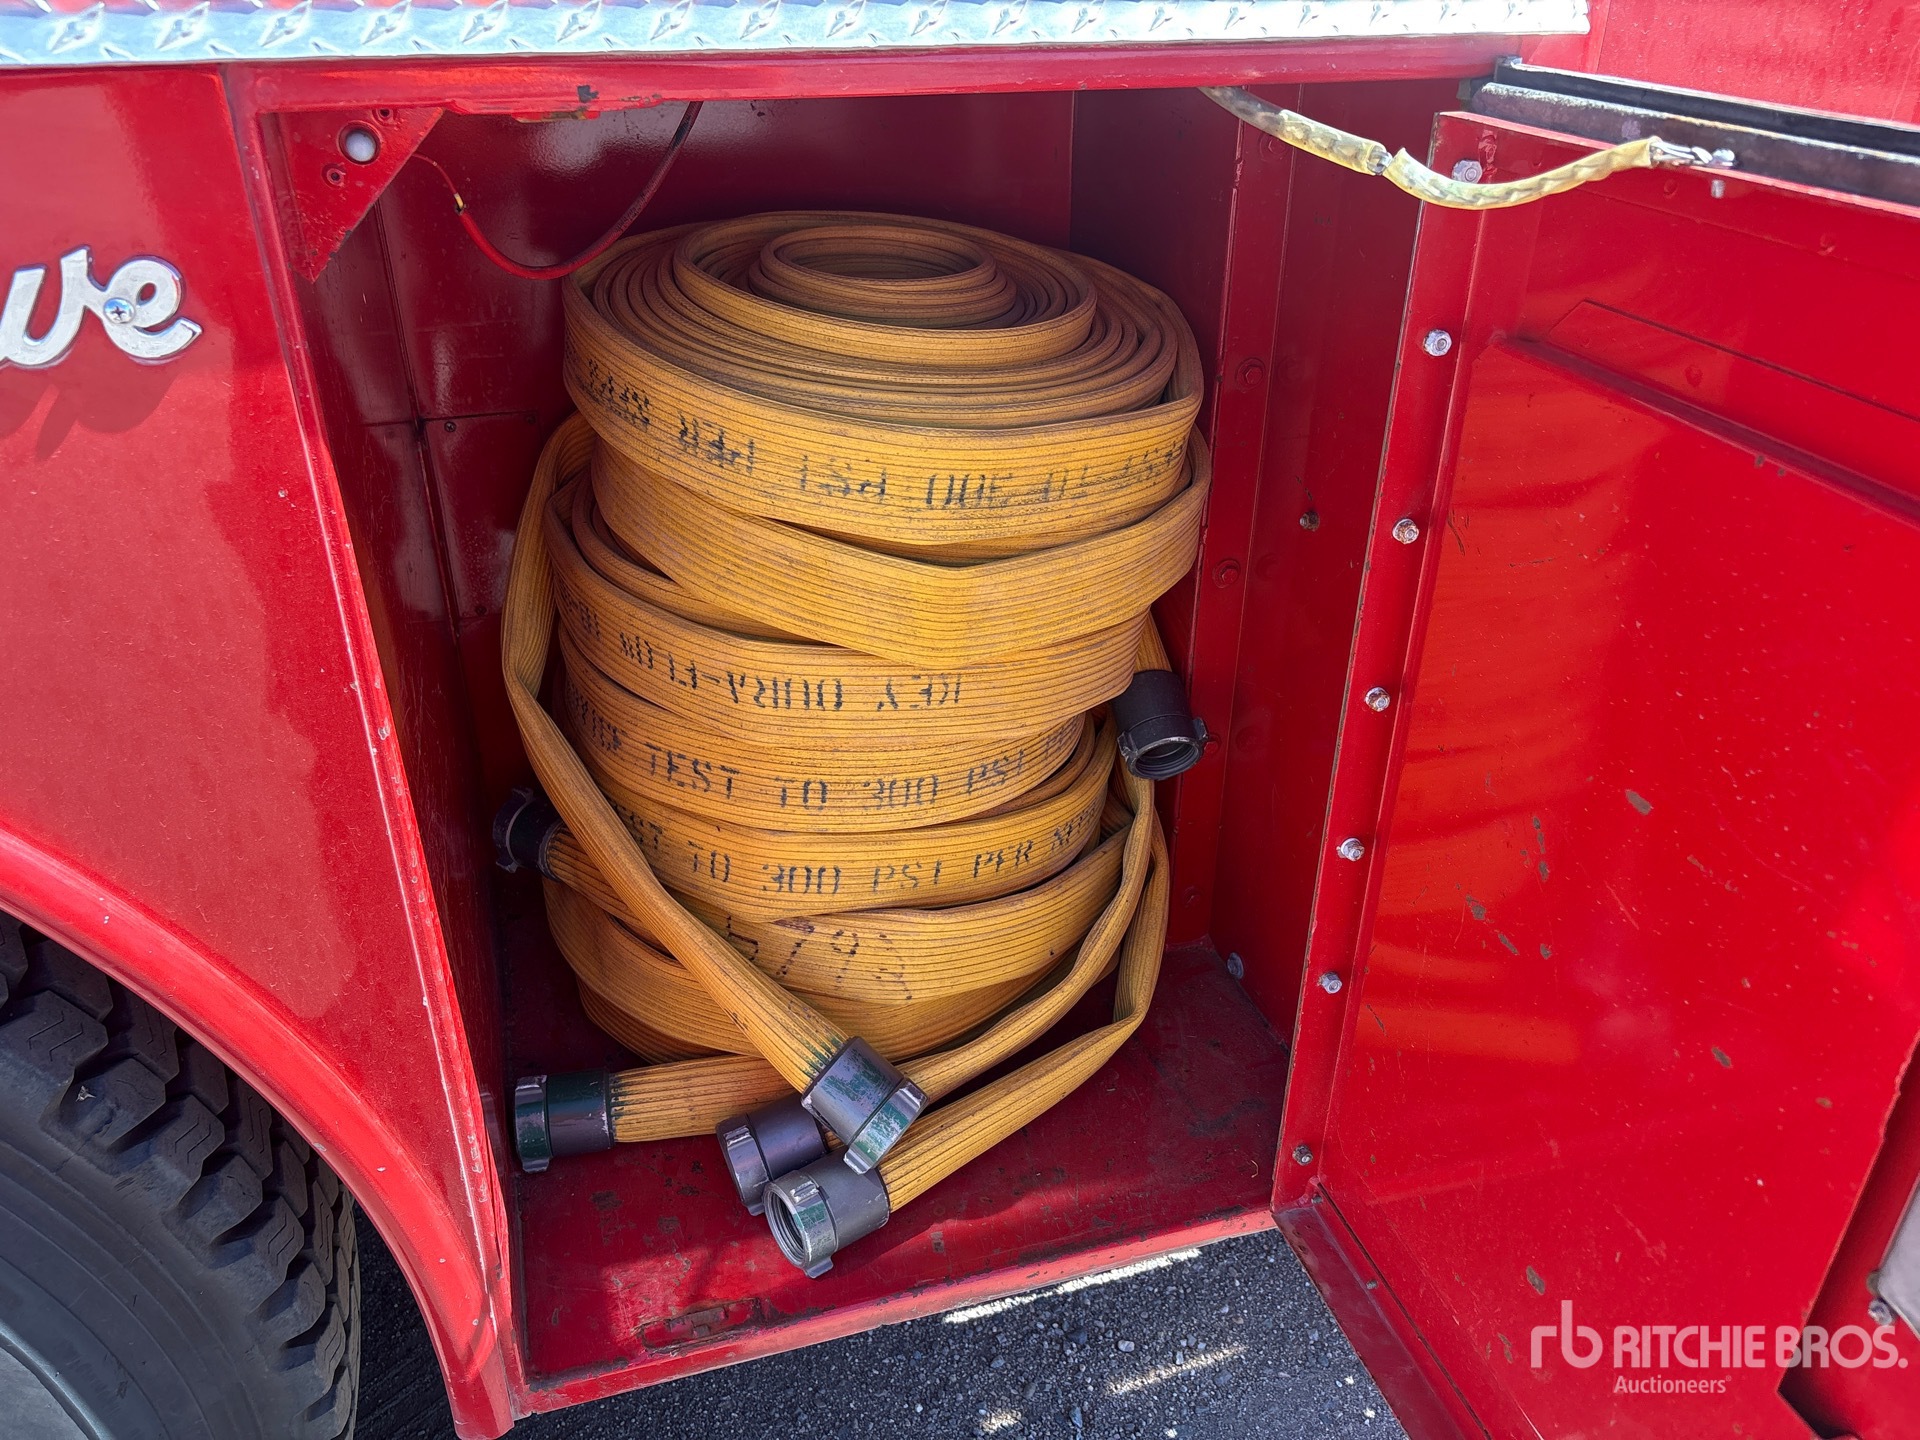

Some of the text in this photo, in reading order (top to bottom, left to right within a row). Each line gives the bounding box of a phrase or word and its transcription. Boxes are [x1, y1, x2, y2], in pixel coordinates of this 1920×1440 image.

[675, 408, 757, 471] PER
[799, 452, 889, 504] PSI
[876, 671, 963, 712] KEY
[643, 740, 741, 800] TEST
[774, 775, 829, 810] TO
[861, 774, 940, 811] 300
[966, 748, 1026, 797] PSI
[687, 839, 732, 883] TO
[761, 862, 842, 895] 300
[872, 859, 942, 894] PSI
[973, 838, 1034, 879] PER
